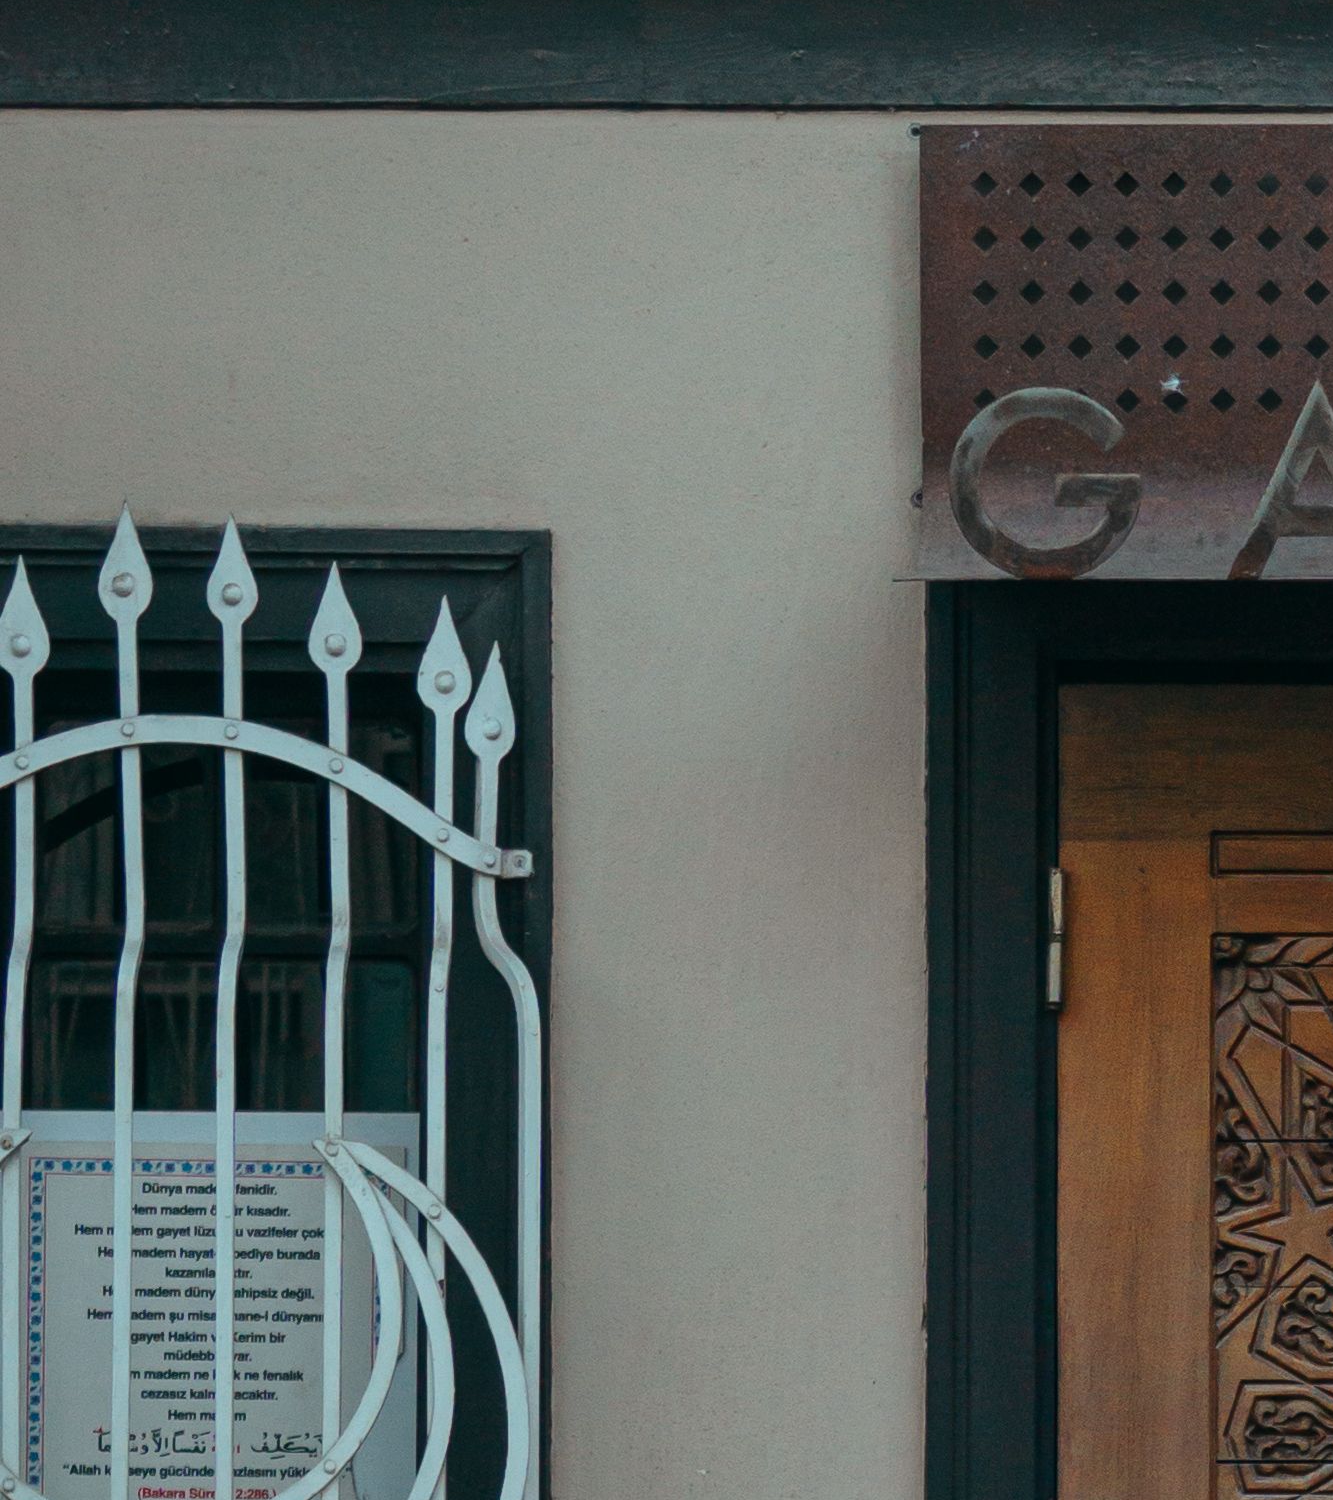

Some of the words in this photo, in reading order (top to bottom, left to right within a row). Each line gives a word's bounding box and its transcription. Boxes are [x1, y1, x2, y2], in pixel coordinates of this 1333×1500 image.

[142, 1182, 182, 1196] Dünya
[185, 1184, 216, 1195] made
[160, 1204, 206, 1216] madem
[246, 1205, 291, 1217] kısadır.
[75, 1224, 103, 1235] Hem
[156, 1226, 191, 1239] gayet
[247, 1226, 298, 1238] vazifeler
[98, 1246, 114, 1257] He
[131, 1247, 176, 1258] madem
[277, 1249, 320, 1260] burada
[135, 1286, 181, 1297] madem
[184, 1287, 216, 1301] düny
[233, 1288, 278, 1301] ahipsiz
[281, 1288, 315, 1302] değil.
[131, 1309, 165, 1320] adem
[169, 1312, 184, 1323] şu
[131, 1332, 165, 1344] gayet
[168, 1332, 208, 1343] Hakim
[269, 1333, 286, 1344] bir
[144, 1369, 191, 1380] madem
[193, 1371, 209, 1380] ne
[244, 1371, 260, 1381] ne
[263, 1370, 304, 1381] fenalık
[140, 1389, 187, 1399] cezasız
[168, 1409, 196, 1420] Hem
[160, 1466, 215, 1479] gücünde
[138, 1488, 186, 1500] (Bakara
